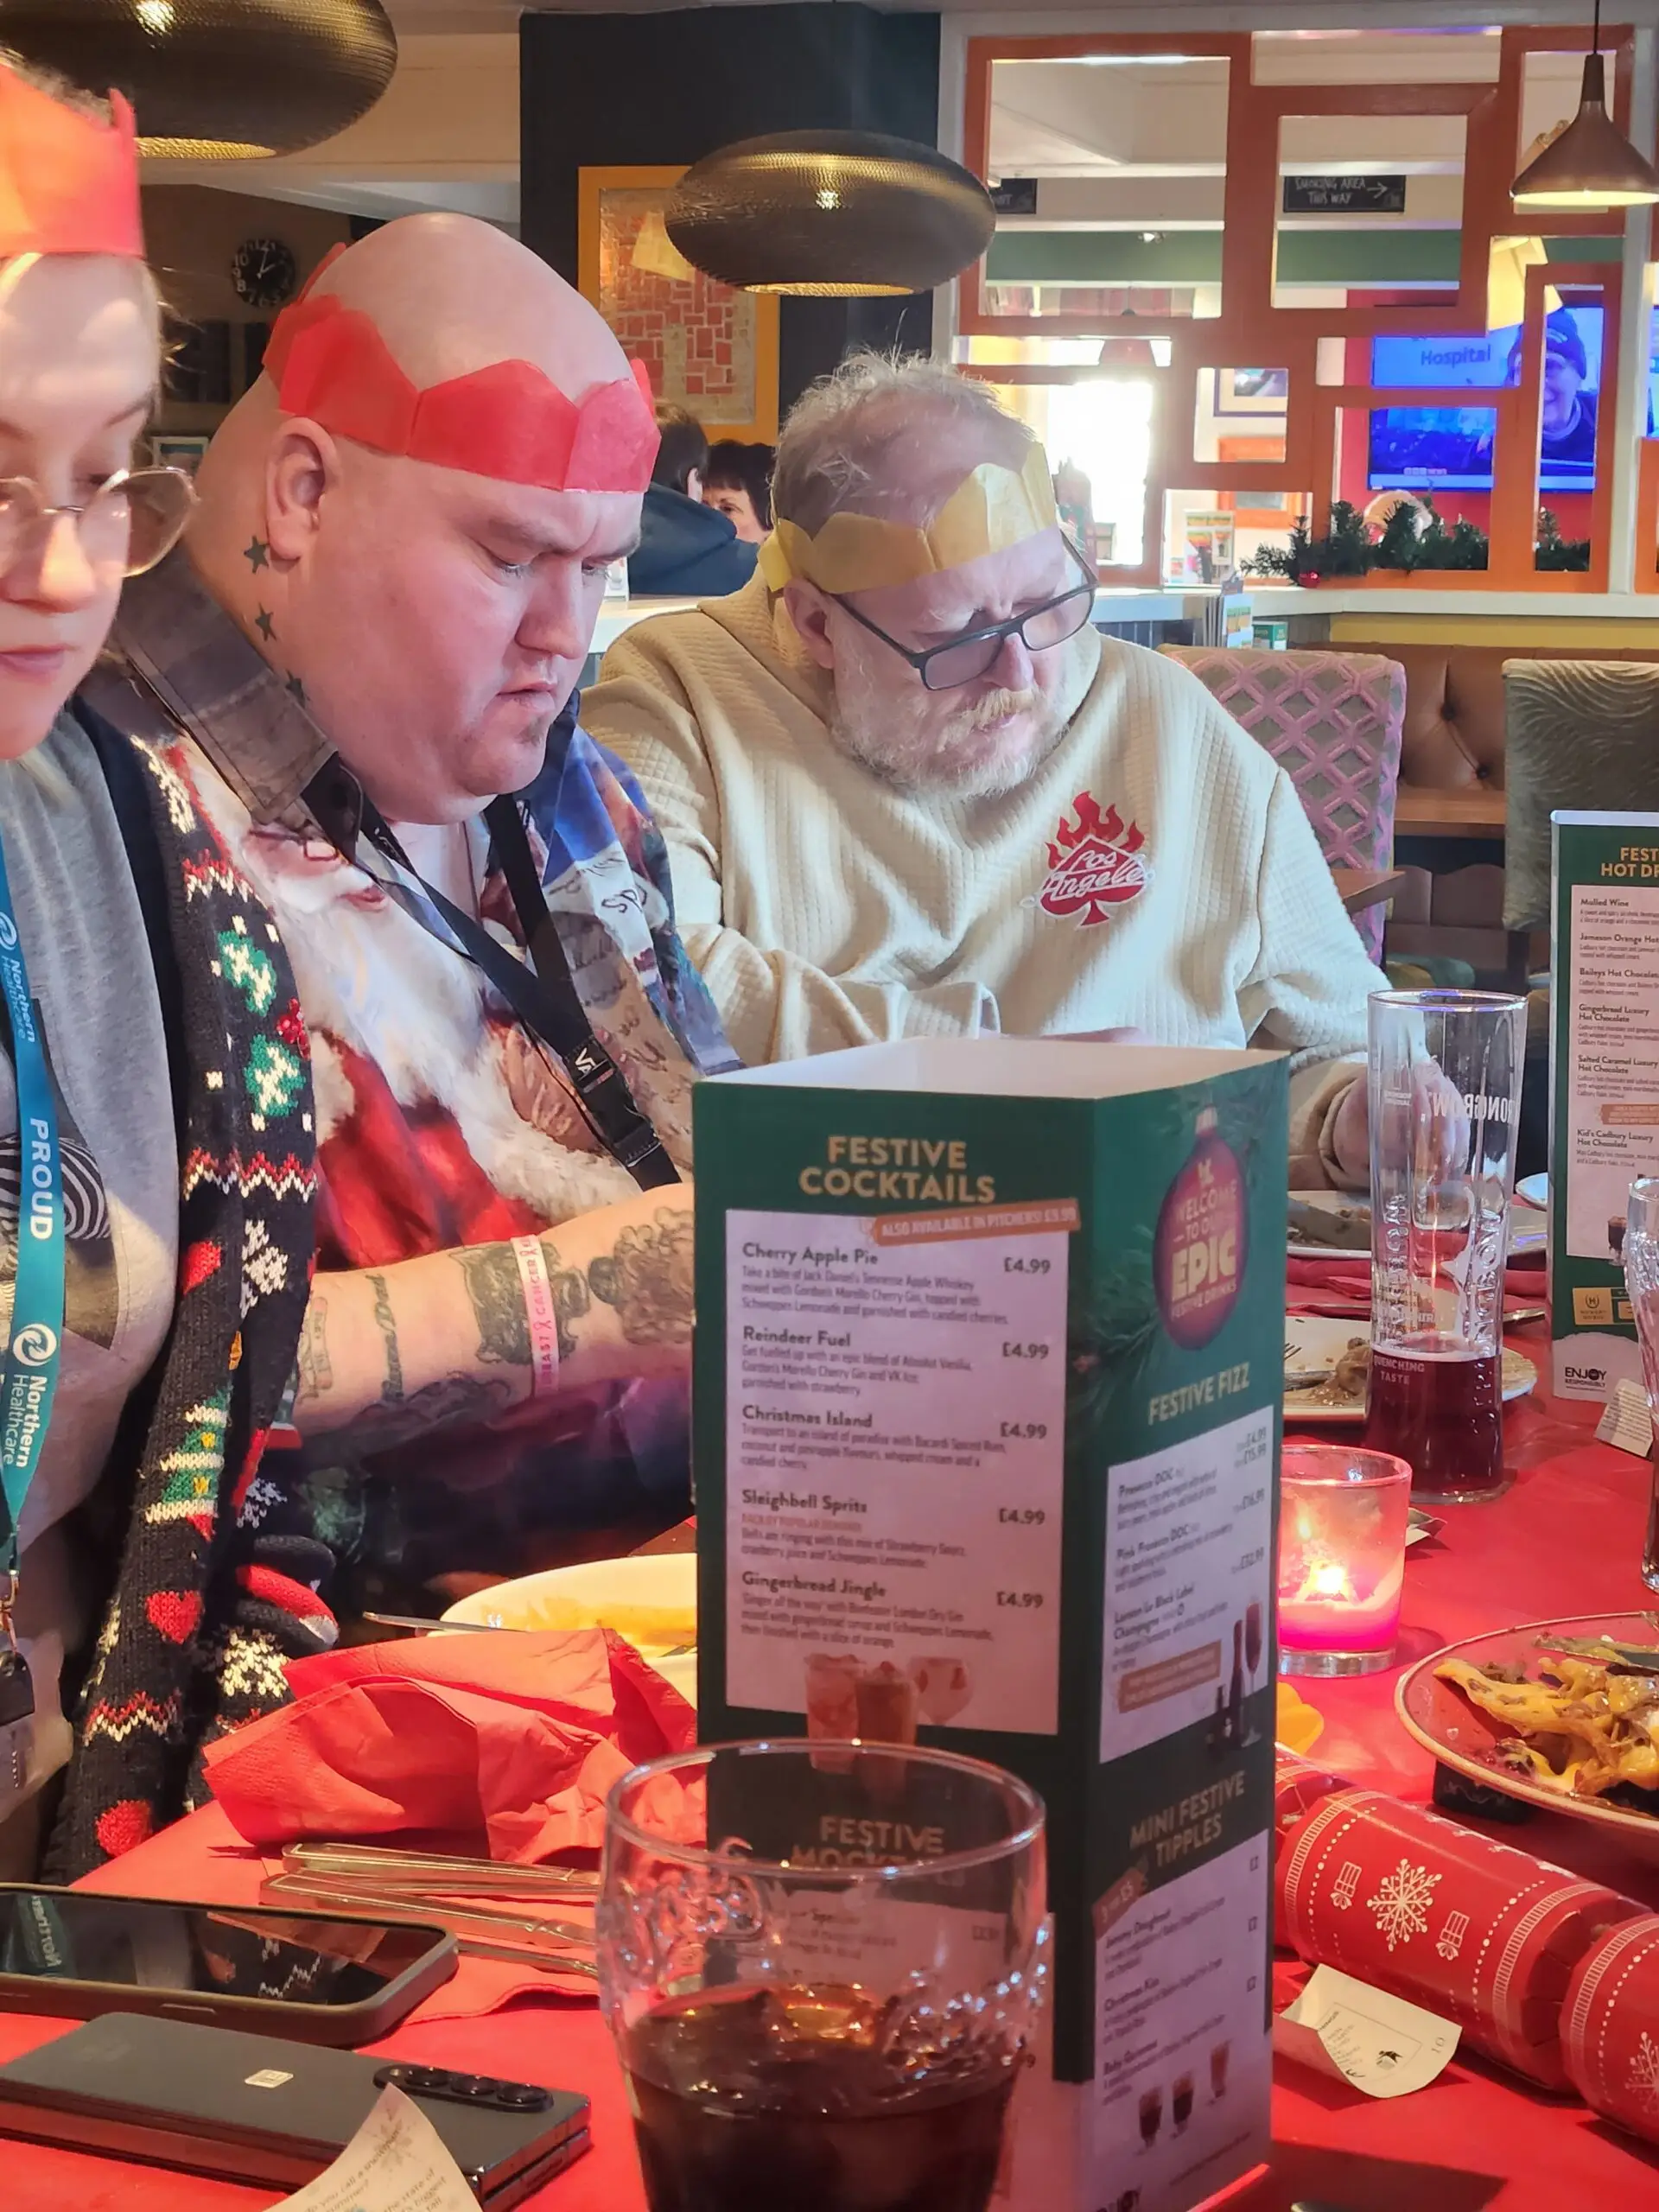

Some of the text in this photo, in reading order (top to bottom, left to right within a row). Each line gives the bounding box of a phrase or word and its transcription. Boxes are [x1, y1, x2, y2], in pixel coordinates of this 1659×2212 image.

[1340, 176, 1366, 189] AREA
[1307, 191, 1353, 205] THIS WAY
[1421, 343, 1491, 369] Hospital
[1601, 863, 1637, 878] HOT
[1609, 899, 1629, 907] Wine
[1580, 933, 1612, 942] Jameson
[1614, 934, 1642, 945] Orange
[1580, 968, 1622, 978] Baileys Hot
[10, 959, 35, 1044] Northern
[1579, 1003, 1650, 1017] Gingerbread Luxury
[1579, 1012, 1630, 1023] Hot Chocolate
[1578, 1054, 1658, 1069] Salted Caramel Luxury
[1578, 1063, 1629, 1074] Hot Chocolate
[1577, 1138, 1628, 1148] Hot Chocolate
[1596, 1129, 1626, 1142] Cadbury
[1628, 1131, 1654, 1143] Luxury
[827, 1135, 968, 1170] FESTIVE
[29, 1116, 53, 1241] PROUD
[798, 1166, 996, 1205] COCKTAILS
[1176, 1179, 1238, 1224] WELCOME
[882, 1223, 909, 1237] ALSO
[912, 1216, 972, 1236] AVAILABLE
[1185, 1220, 1199, 1242] TO
[742, 1242, 879, 1267] Cherry Apple Pie
[1004, 1256, 1051, 1274] £4.99
[1171, 1228, 1237, 1303] EPIC
[526, 1258, 547, 1316] CANCER
[743, 1325, 851, 1348] Reindeer Fuel
[1002, 1341, 1050, 1360] £4.99
[1380, 1371, 1411, 1385] TASTE
[1565, 1366, 1607, 1381] ENJOY
[1147, 1361, 1251, 1427] FESTIVE FIZZ
[2, 1372, 29, 1467] Healthcare
[16, 1375, 48, 1469] Northern
[742, 1404, 873, 1427] Christmas Island
[1000, 1421, 1048, 1440] £4.99
[742, 1489, 818, 1511] Sleighbell
[999, 1507, 1046, 1526] £4.99
[742, 1570, 887, 1601] Gingerbread Jingle
[996, 1590, 1045, 1609] £4.99
[1128, 1769, 1246, 1852] MINI FESTIVE
[820, 1815, 945, 1856] FESTIVE
[1155, 1812, 1222, 1868] TIPPLES
[364, 2128, 401, 2171] snowman
